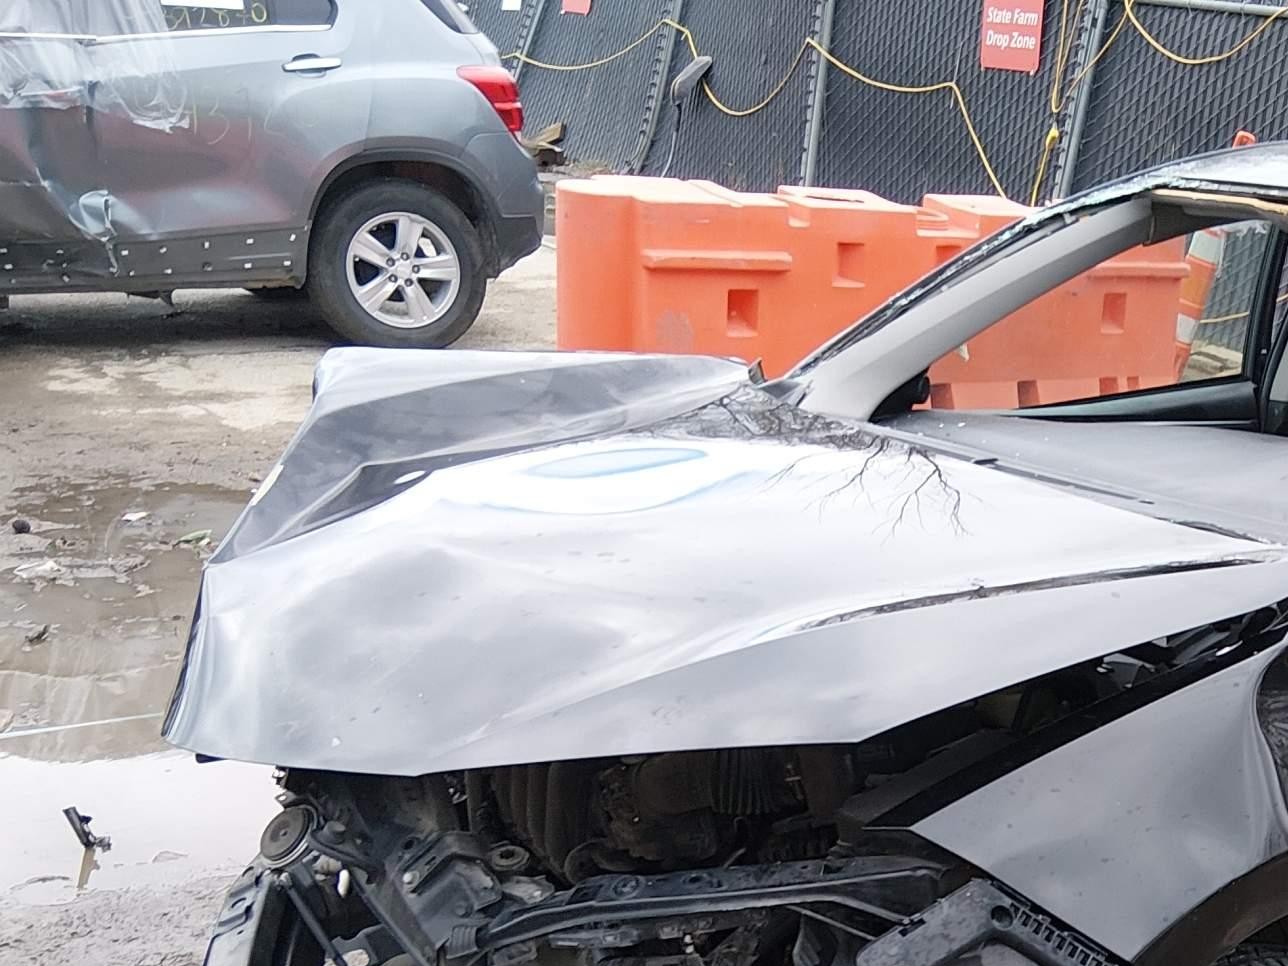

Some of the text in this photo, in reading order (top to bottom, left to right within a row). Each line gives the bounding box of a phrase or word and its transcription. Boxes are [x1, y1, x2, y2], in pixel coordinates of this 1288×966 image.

[986, 6, 1038, 26] State Farm
[985, 29, 1036, 50] Drop Zone
